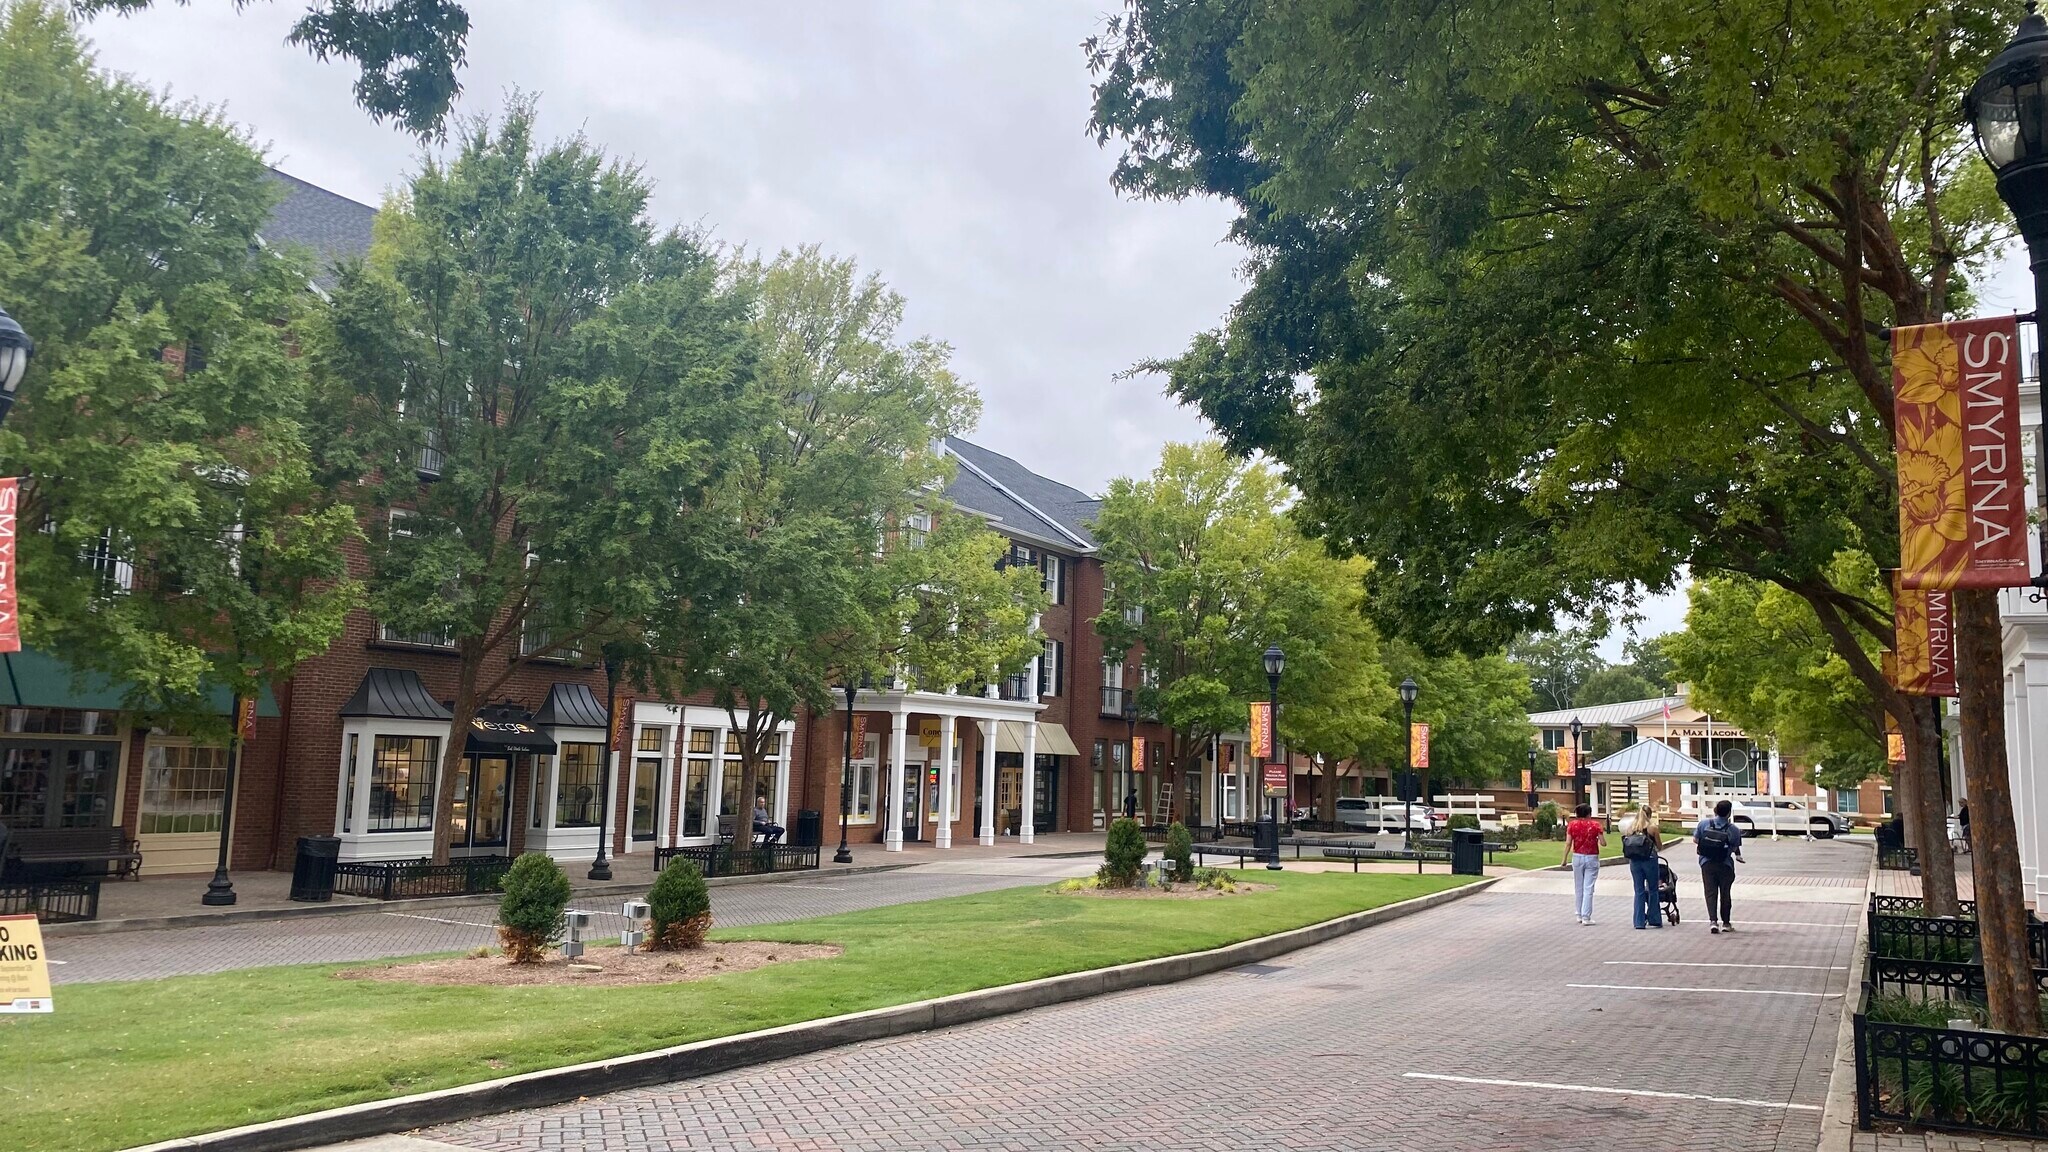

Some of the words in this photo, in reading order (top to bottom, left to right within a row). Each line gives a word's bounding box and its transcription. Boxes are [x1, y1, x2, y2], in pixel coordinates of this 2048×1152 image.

[1963, 331, 2010, 550] SMYRNA
[1928, 589, 1948, 678] MYRNA
[615, 698, 630, 743] SMYRNA
[857, 716, 867, 754] SMYRNA
[1261, 704, 1270, 750] SMYRNA
[1420, 725, 1428, 761] SMYRNA
